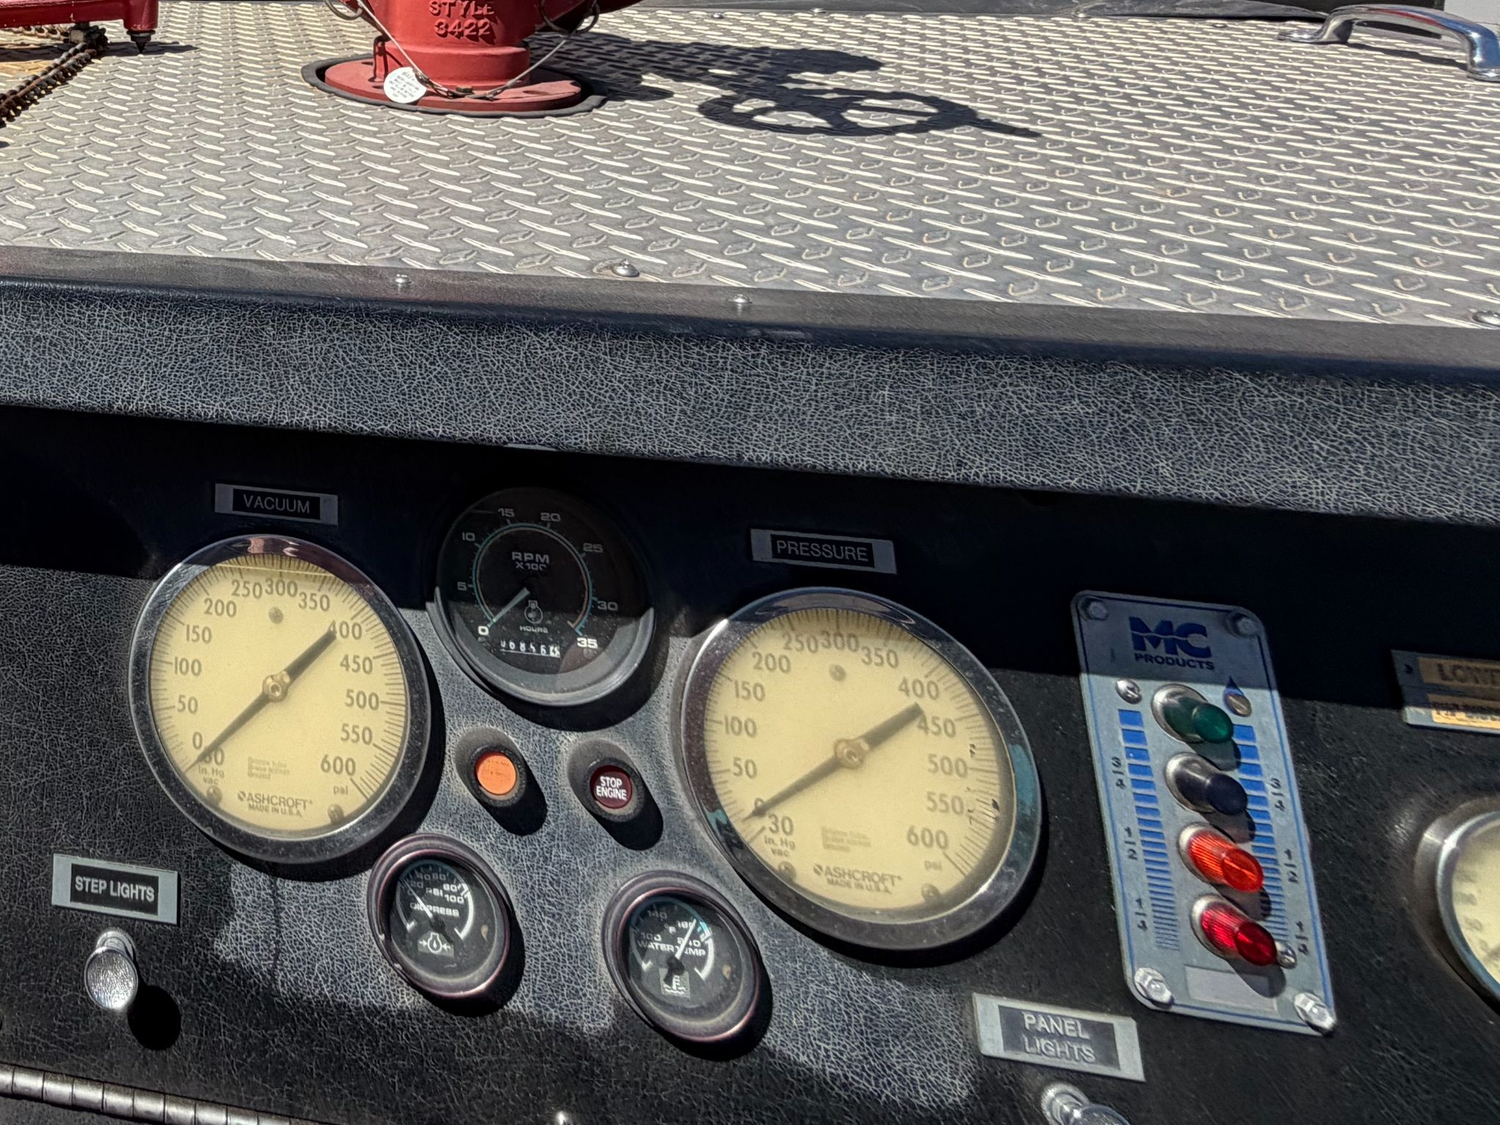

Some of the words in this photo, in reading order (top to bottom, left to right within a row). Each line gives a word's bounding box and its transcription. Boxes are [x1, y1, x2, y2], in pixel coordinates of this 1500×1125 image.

[434, 18, 493, 38] 3422
[243, 494, 310, 514] VACUUM
[498, 508, 515, 518] 15
[540, 512, 561, 522] 20
[462, 532, 476, 542] 10
[511, 551, 550, 564] RPM
[583, 543, 604, 553] 25
[776, 540, 869, 562] PRESSURE
[231, 579, 262, 599] 250
[265, 578, 299, 597] 300
[457, 581, 468, 591] 5
[204, 598, 237, 618] 200
[298, 592, 330, 612] 350
[597, 600, 618, 611] 30
[185, 624, 213, 644] 150
[477, 626, 489, 636] 0
[519, 625, 549, 634] HOURS
[1129, 616, 1212, 659] MC
[577, 637, 599, 649] 35
[782, 633, 819, 654] 250
[819, 631, 859, 653] 300
[174, 657, 202, 676] 100
[340, 655, 374, 675] 450
[752, 652, 791, 674] 200
[861, 647, 899, 668] 350
[1134, 652, 1216, 671] PRODUCTS
[734, 681, 766, 702] 150
[898, 677, 940, 700] 400
[177, 694, 199, 715] 50
[345, 689, 379, 711] 500
[341, 724, 373, 745] 550
[724, 716, 757, 738] 100
[918, 715, 957, 738] 450
[192, 732, 203, 750] 0
[320, 753, 357, 777] 600
[732, 758, 758, 779] 50
[927, 754, 968, 777] 500
[202, 776, 219, 786] vac
[600, 776, 623, 789] STOP
[247, 792, 309, 810] ASHCROFT
[596, 785, 627, 802] ENGINE
[926, 792, 965, 815] 550
[768, 814, 795, 836] 30
[906, 825, 950, 850] 600
[825, 865, 896, 887] ASHCROFT
[74, 876, 107, 895] STEP
[109, 880, 156, 904] LIGHTS
[444, 894, 465, 905] 100
[427, 904, 460, 917] PRESS
[647, 910, 668, 919] 140
[638, 940, 674, 954] WATER
[640, 933, 662, 942] 100
[1022, 1011, 1091, 1040] PANEL
[1022, 1034, 1096, 1063] LIGHTS
